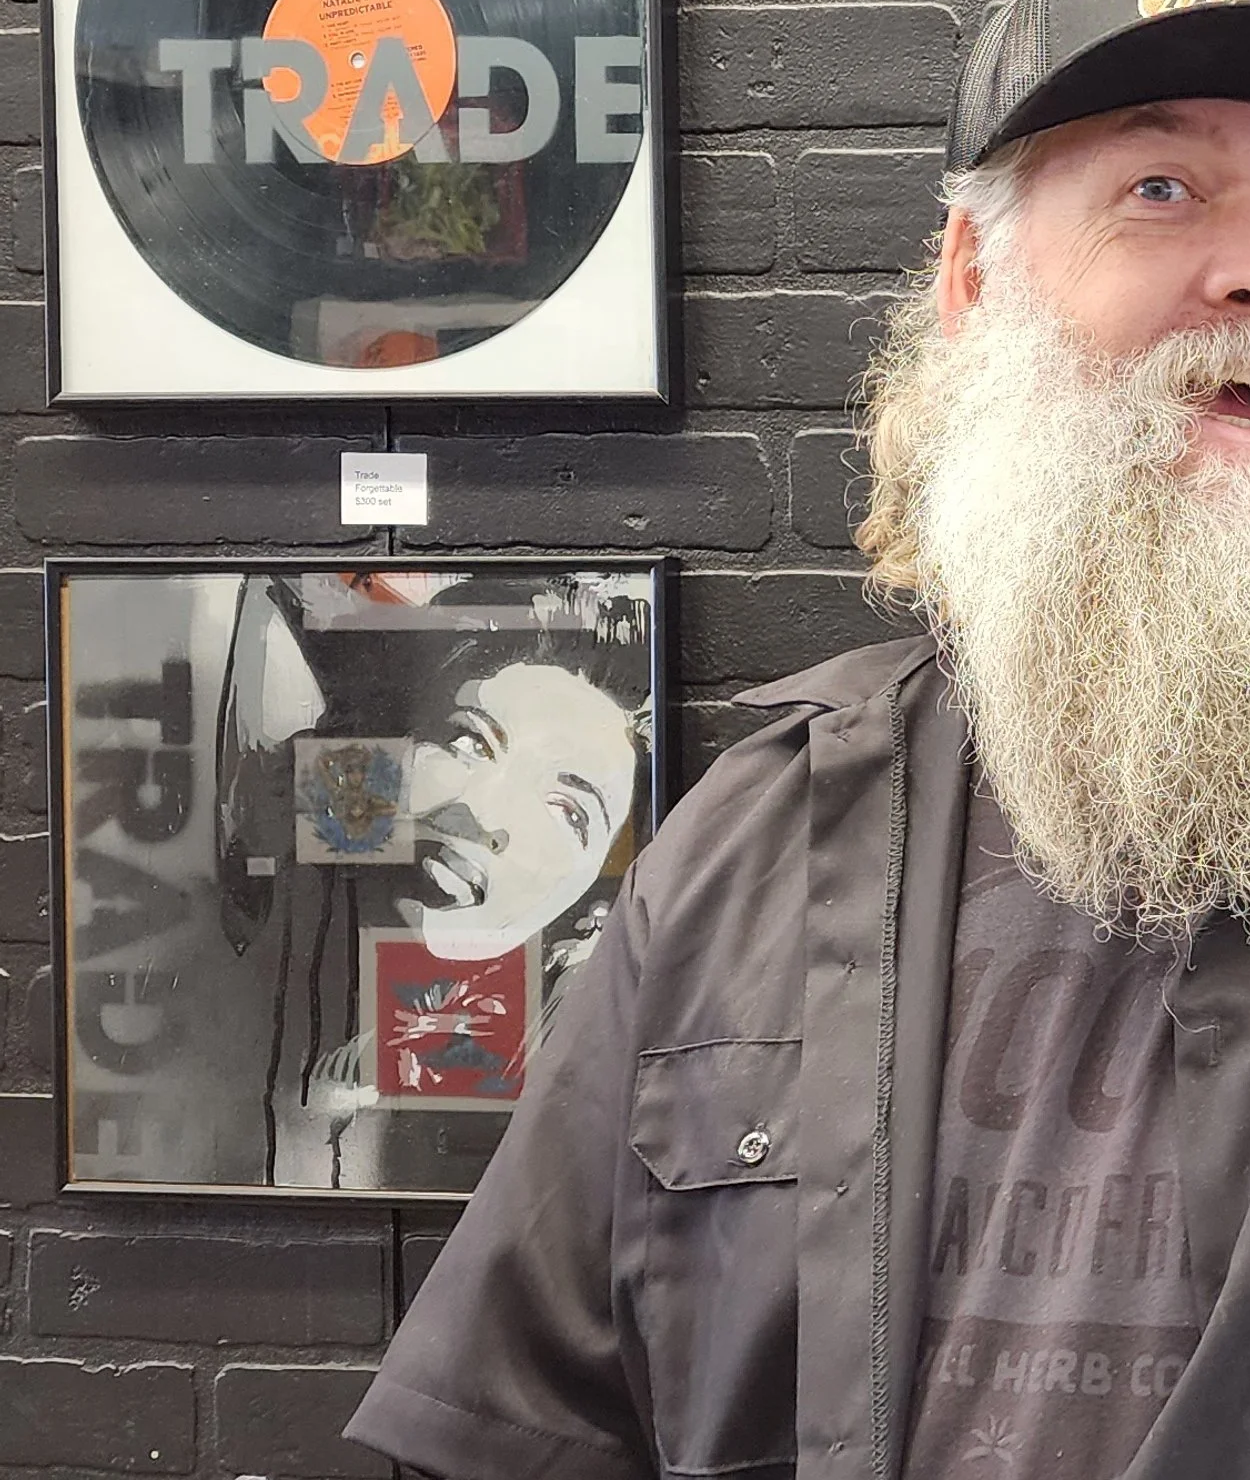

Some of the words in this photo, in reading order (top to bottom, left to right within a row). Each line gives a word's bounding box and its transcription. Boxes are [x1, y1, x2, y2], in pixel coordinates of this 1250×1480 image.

[318, 0, 393, 21] UNPREDICTABLE
[158, 34, 643, 165] TRADE
[354, 470, 380, 480] Trade
